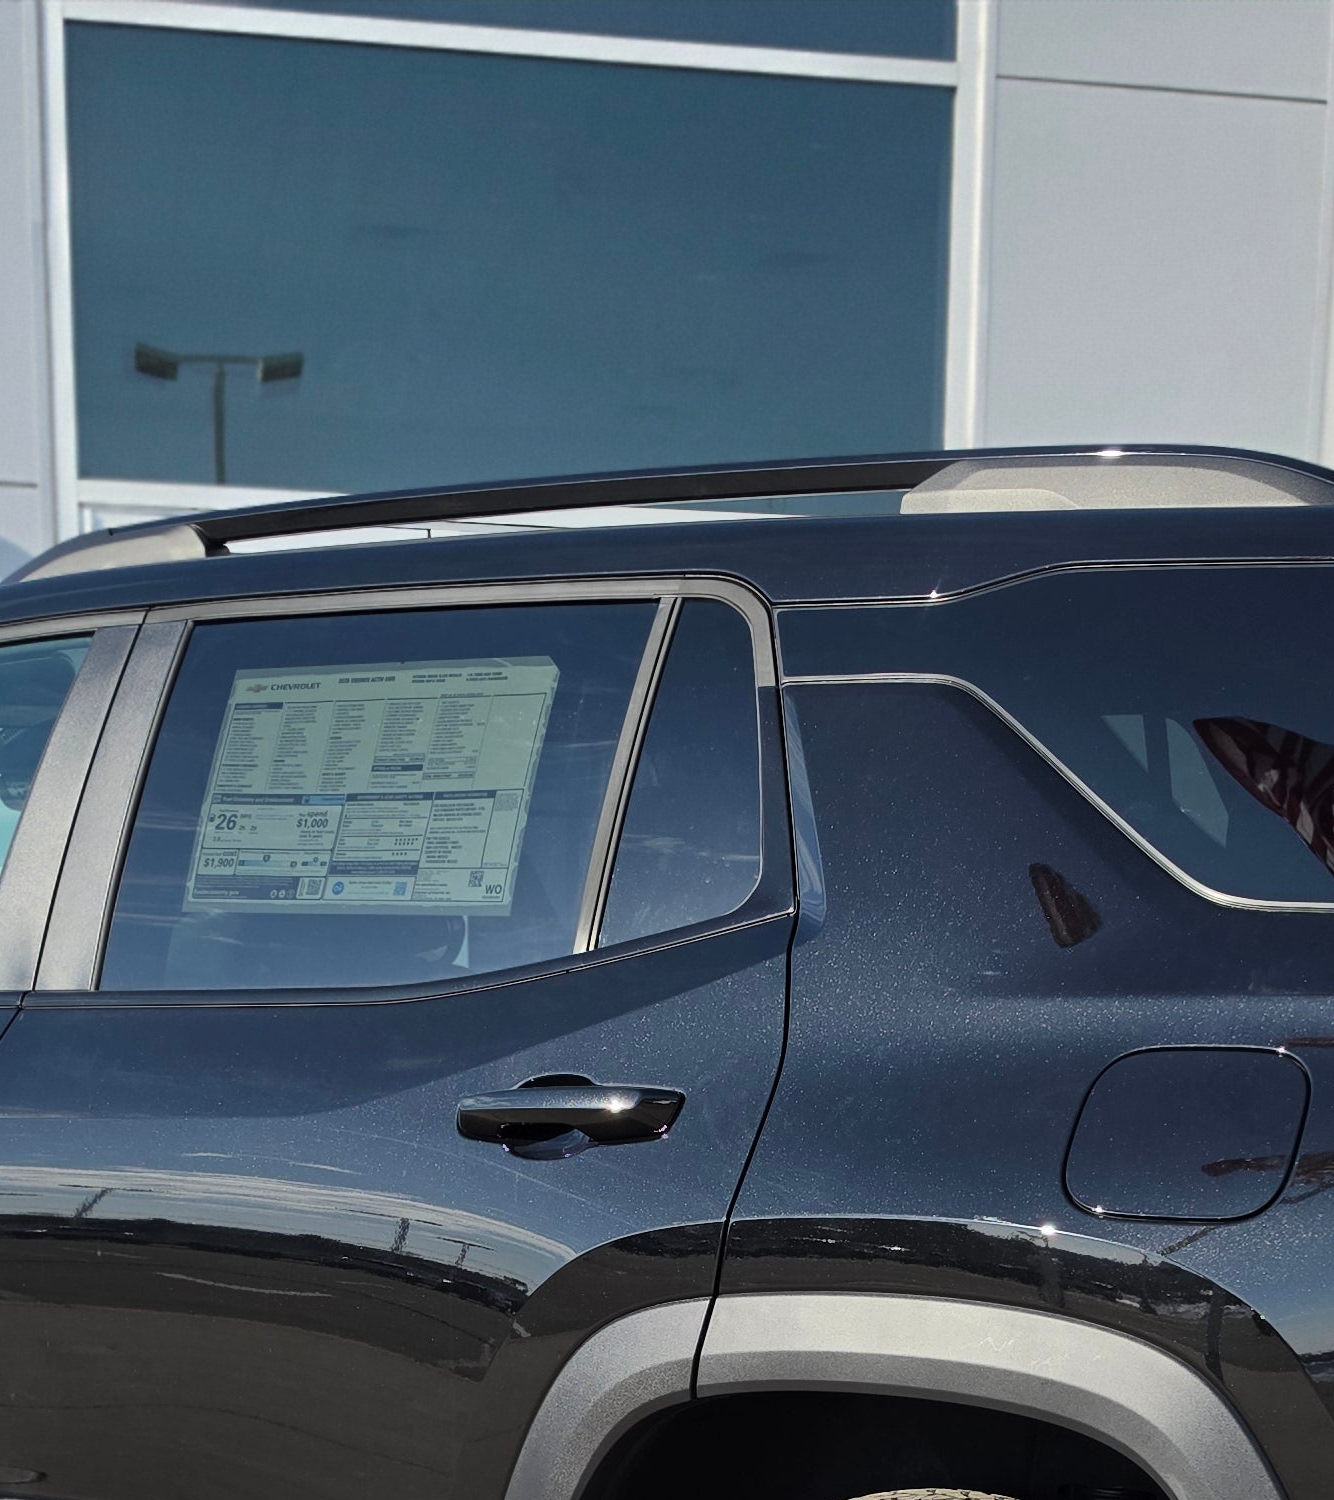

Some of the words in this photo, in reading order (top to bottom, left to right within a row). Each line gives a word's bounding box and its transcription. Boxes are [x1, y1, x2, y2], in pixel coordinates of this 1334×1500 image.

[270, 682, 321, 691] CHEVROLET
[215, 813, 238, 830] 26
[296, 818, 328, 830] $1,000
[203, 857, 235, 868] $1,900
[485, 884, 503, 895] WO
